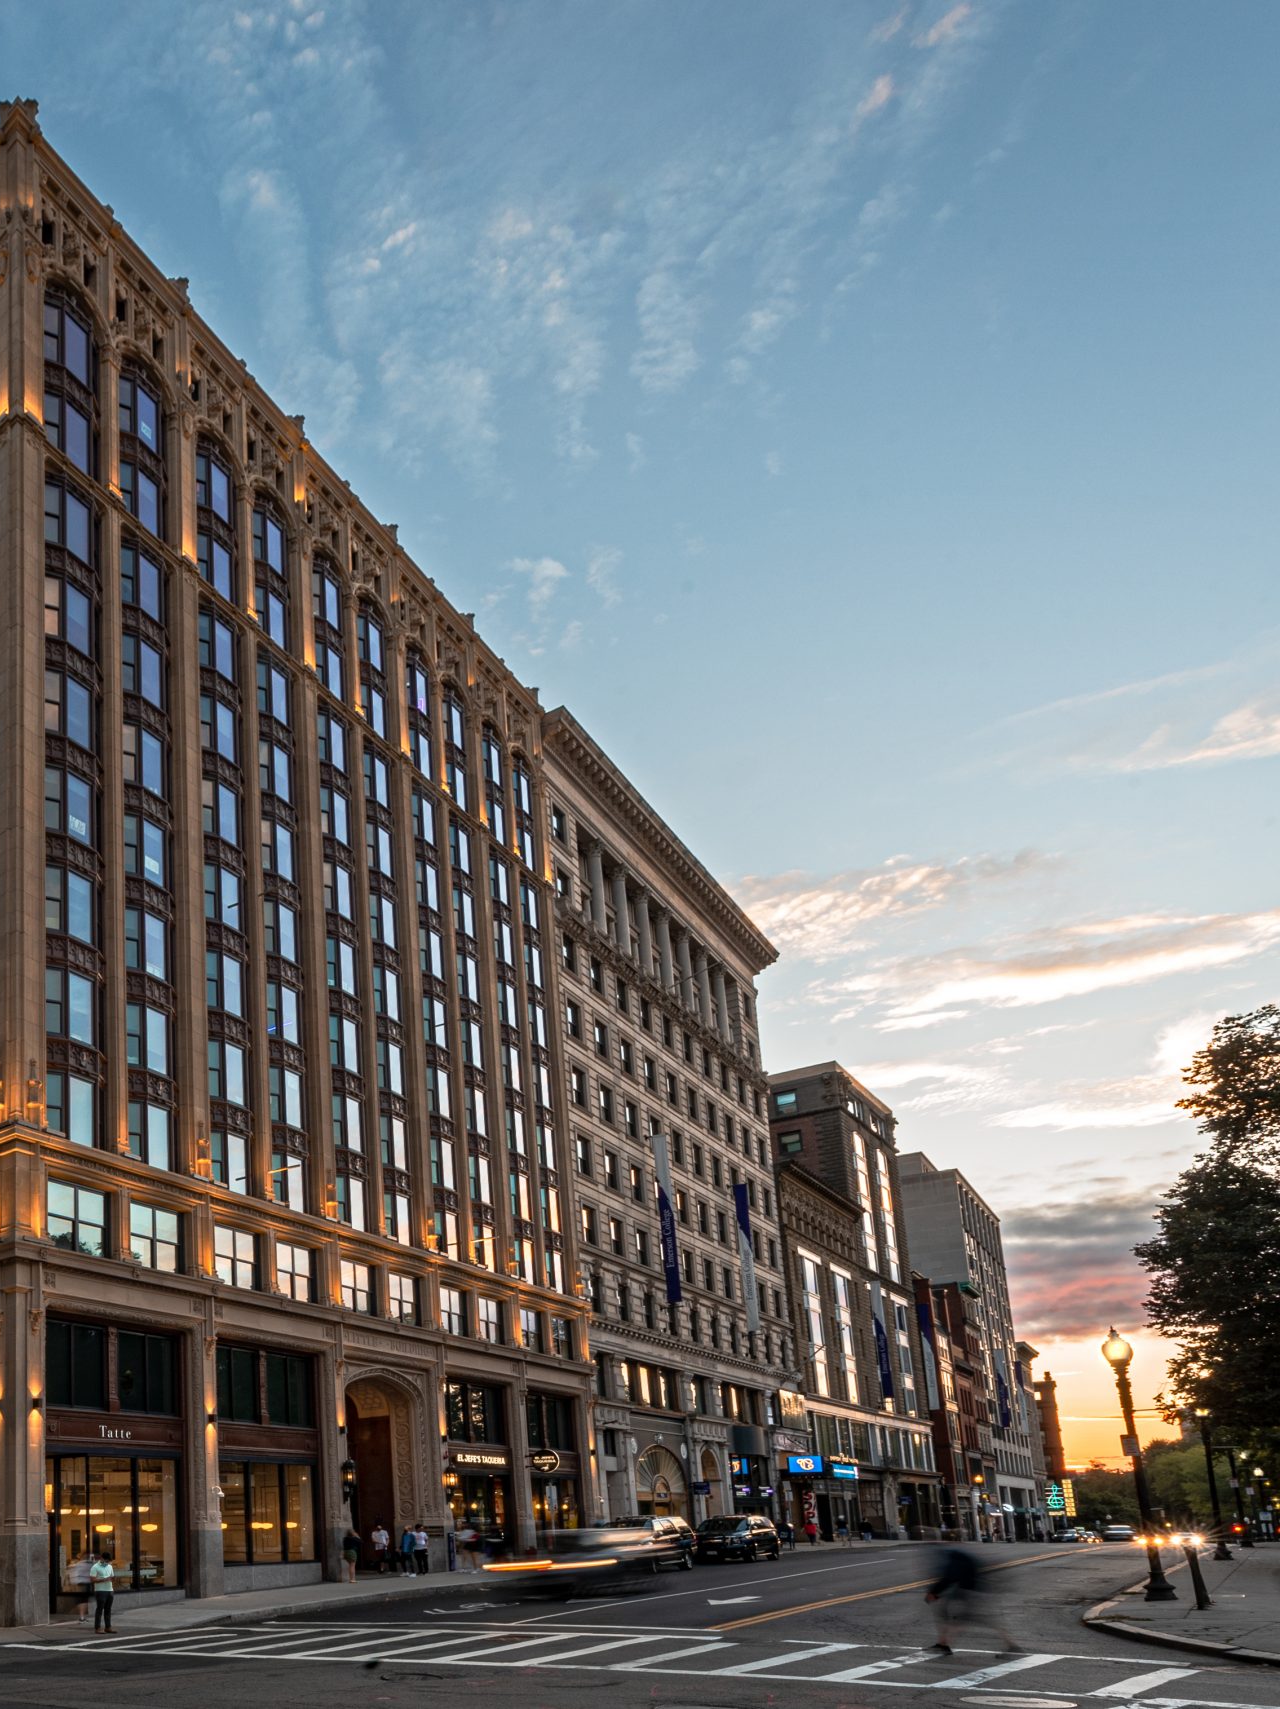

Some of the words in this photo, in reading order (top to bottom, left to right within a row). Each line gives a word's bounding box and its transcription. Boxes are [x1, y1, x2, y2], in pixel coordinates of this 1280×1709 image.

[662, 1209, 672, 1236] College
[666, 1236, 675, 1268] Emerson
[744, 1273, 753, 1301] Emerson
[99, 1424, 131, 1439] Tatte
[457, 1454, 464, 1462] EL
[464, 1454, 481, 1463] JEFE'S
[481, 1455, 506, 1465] TAQUERIA
